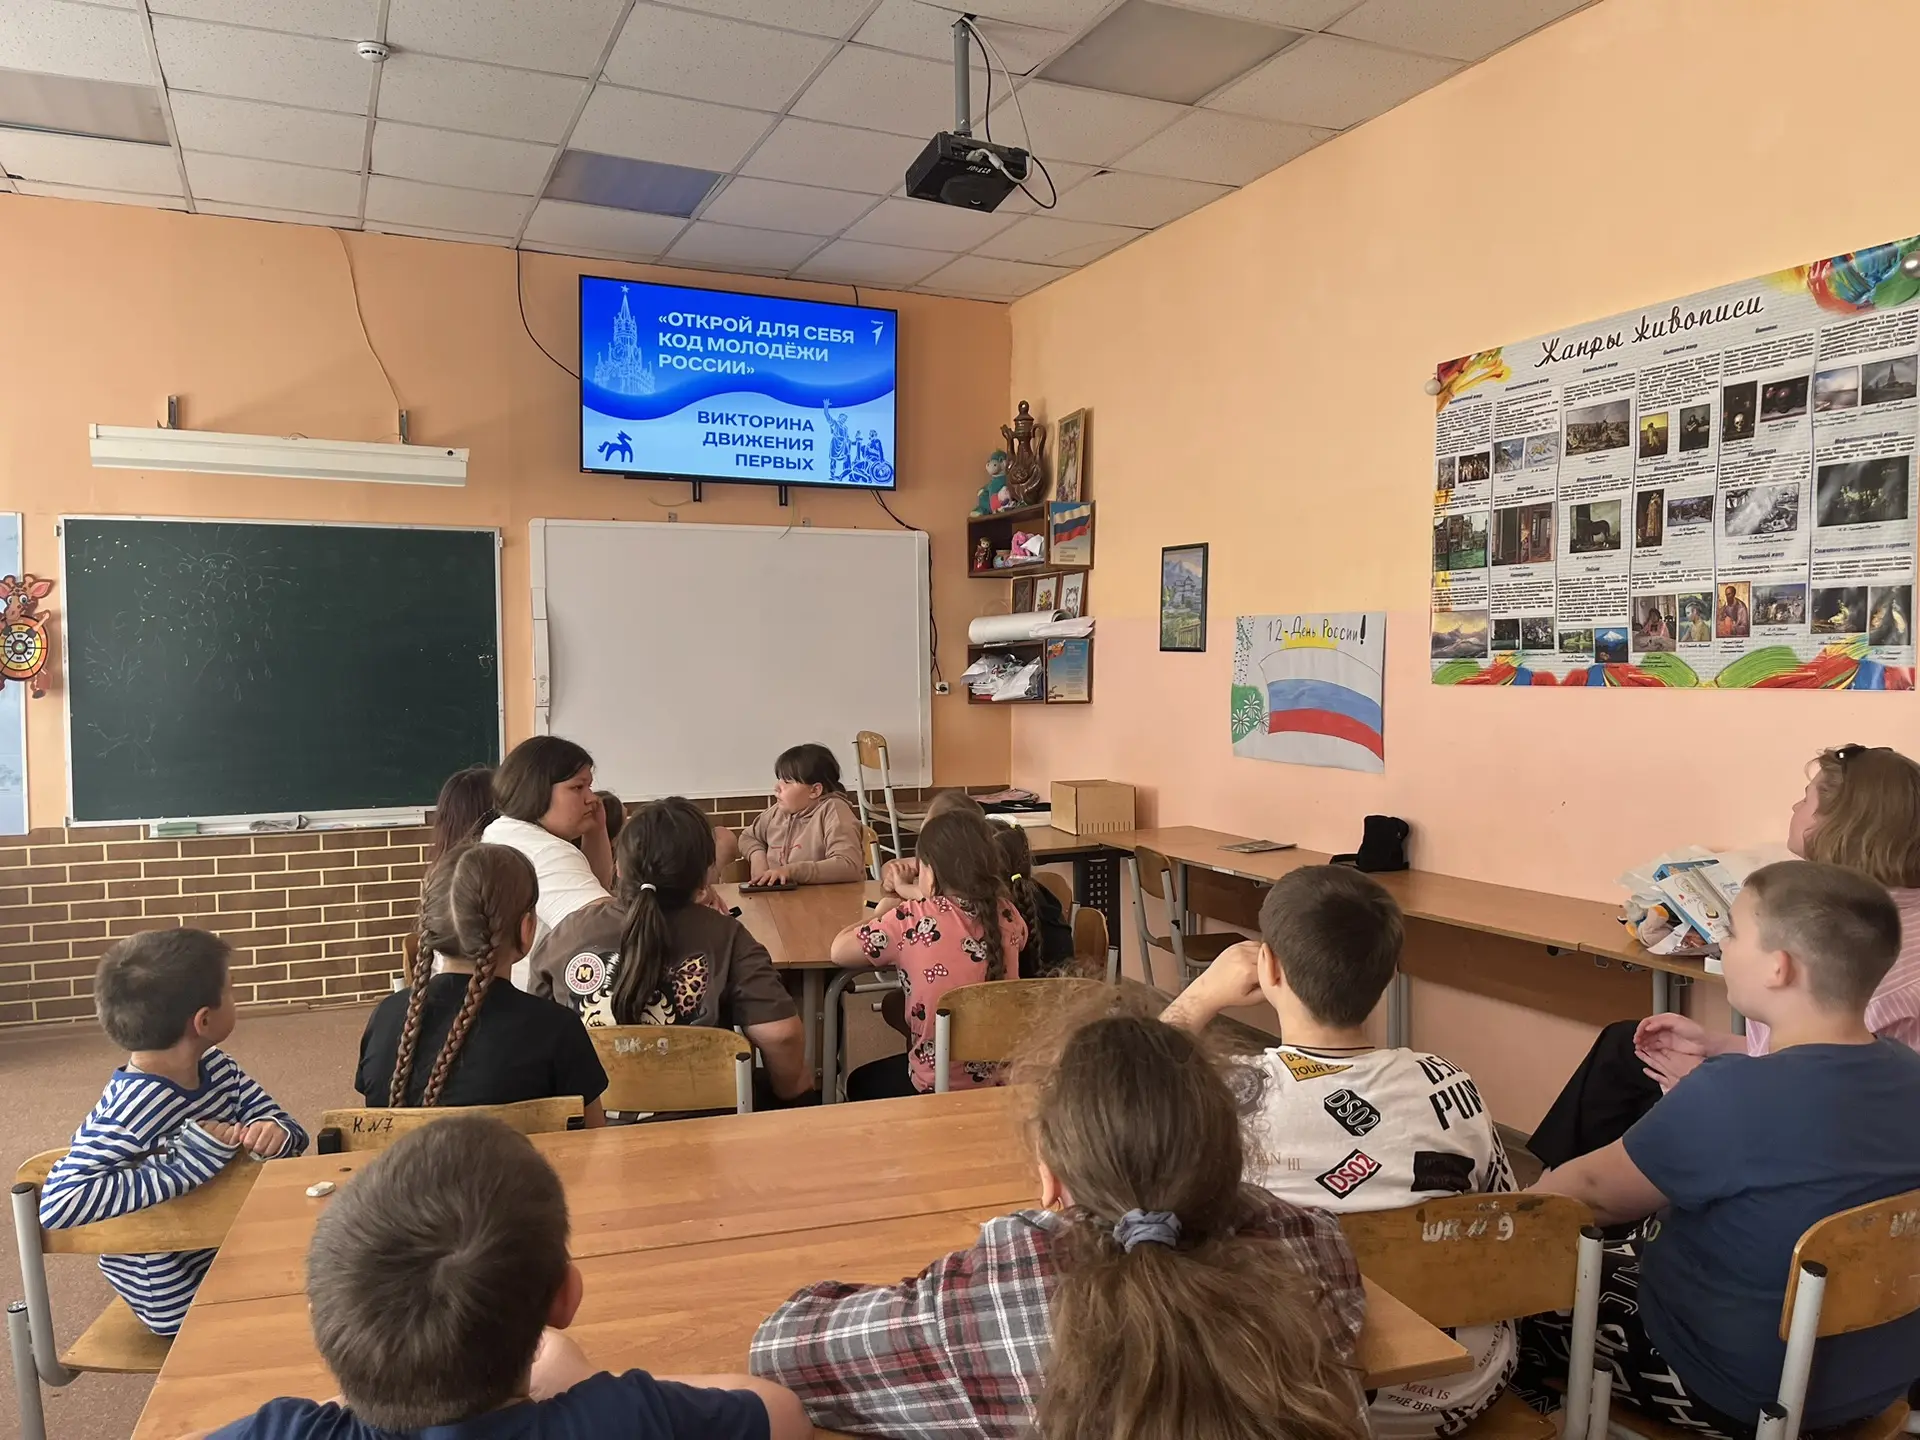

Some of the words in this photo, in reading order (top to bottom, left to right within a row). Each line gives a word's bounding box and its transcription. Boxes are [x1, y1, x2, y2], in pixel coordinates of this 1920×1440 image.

[658, 311, 753, 334] «ОТКРОЙ
[756, 322, 800, 338] ДЛЯ
[803, 326, 855, 344] СЕБЯ
[658, 333, 703, 352] КОД
[707, 336, 829, 362] МОЛОДЁЖИ
[1534, 332, 1624, 368] Жанры
[658, 354, 755, 375] РОССИИ»
[697, 411, 814, 432] ВИКТОРИНА
[702, 431, 814, 452] ДВИЖЕНИЯ
[735, 454, 814, 471] ПЕРВЫХ
[1322, 614, 1367, 645] России!
[577, 966, 592, 980] M
[1292, 1063, 1325, 1076] TOUR
[1497, 1212, 1514, 1241] 9
[1436, 1389, 1452, 1400] IS
